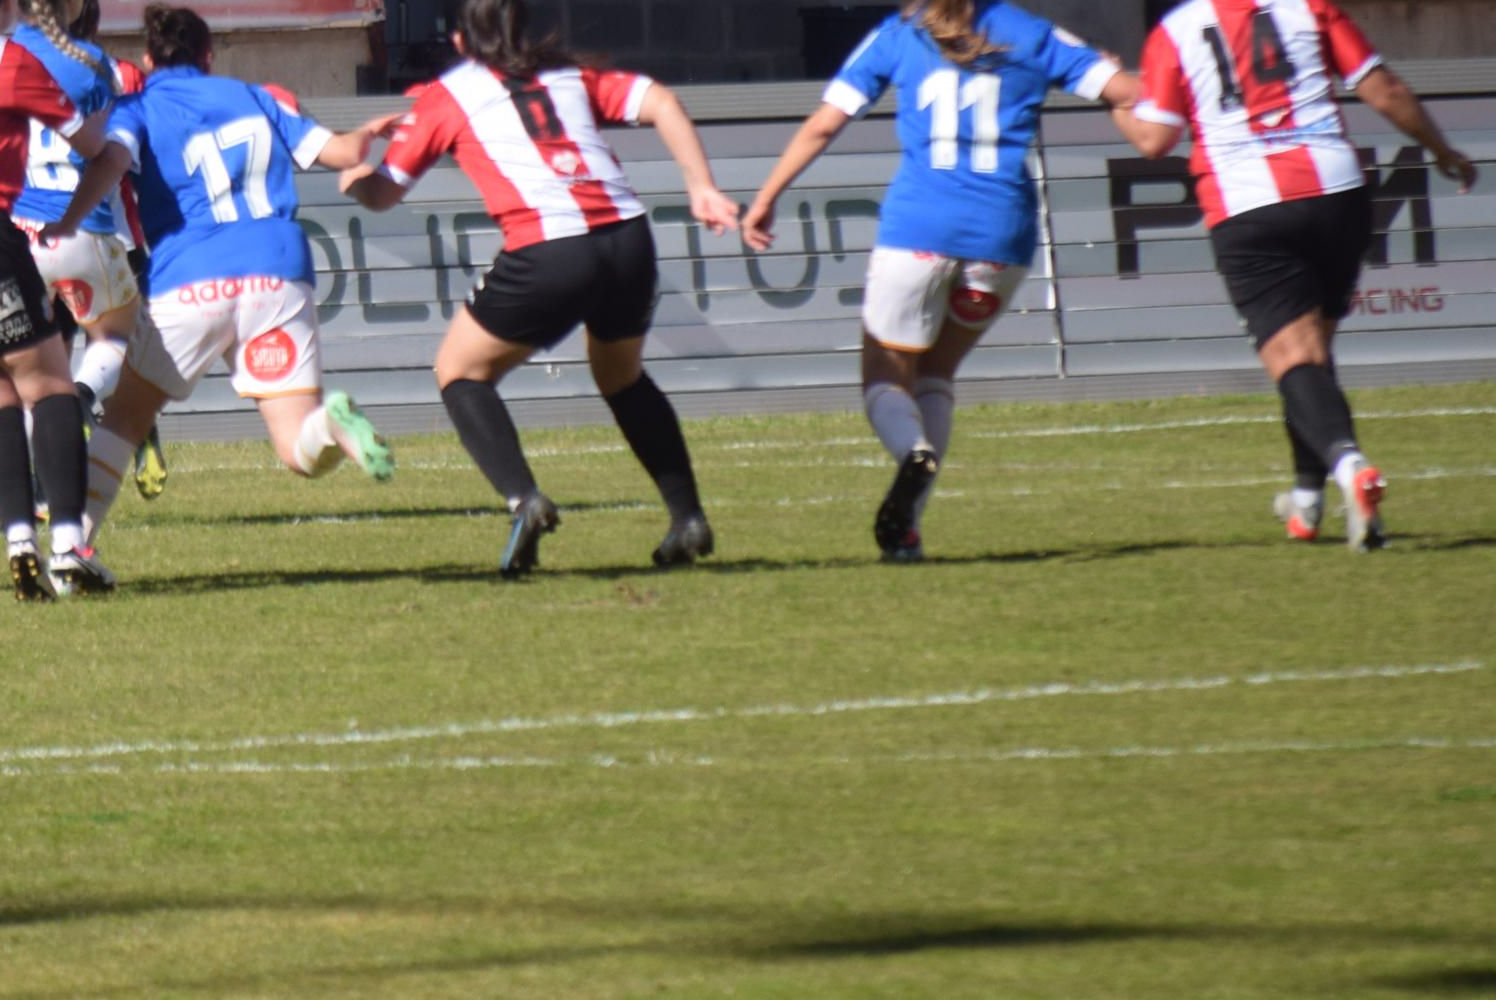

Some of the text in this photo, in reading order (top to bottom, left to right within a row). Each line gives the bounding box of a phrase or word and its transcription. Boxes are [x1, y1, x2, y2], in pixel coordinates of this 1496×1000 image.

[1201, 8, 1295, 113] 14
[182, 114, 274, 223] 17
[916, 67, 1002, 174] 11
